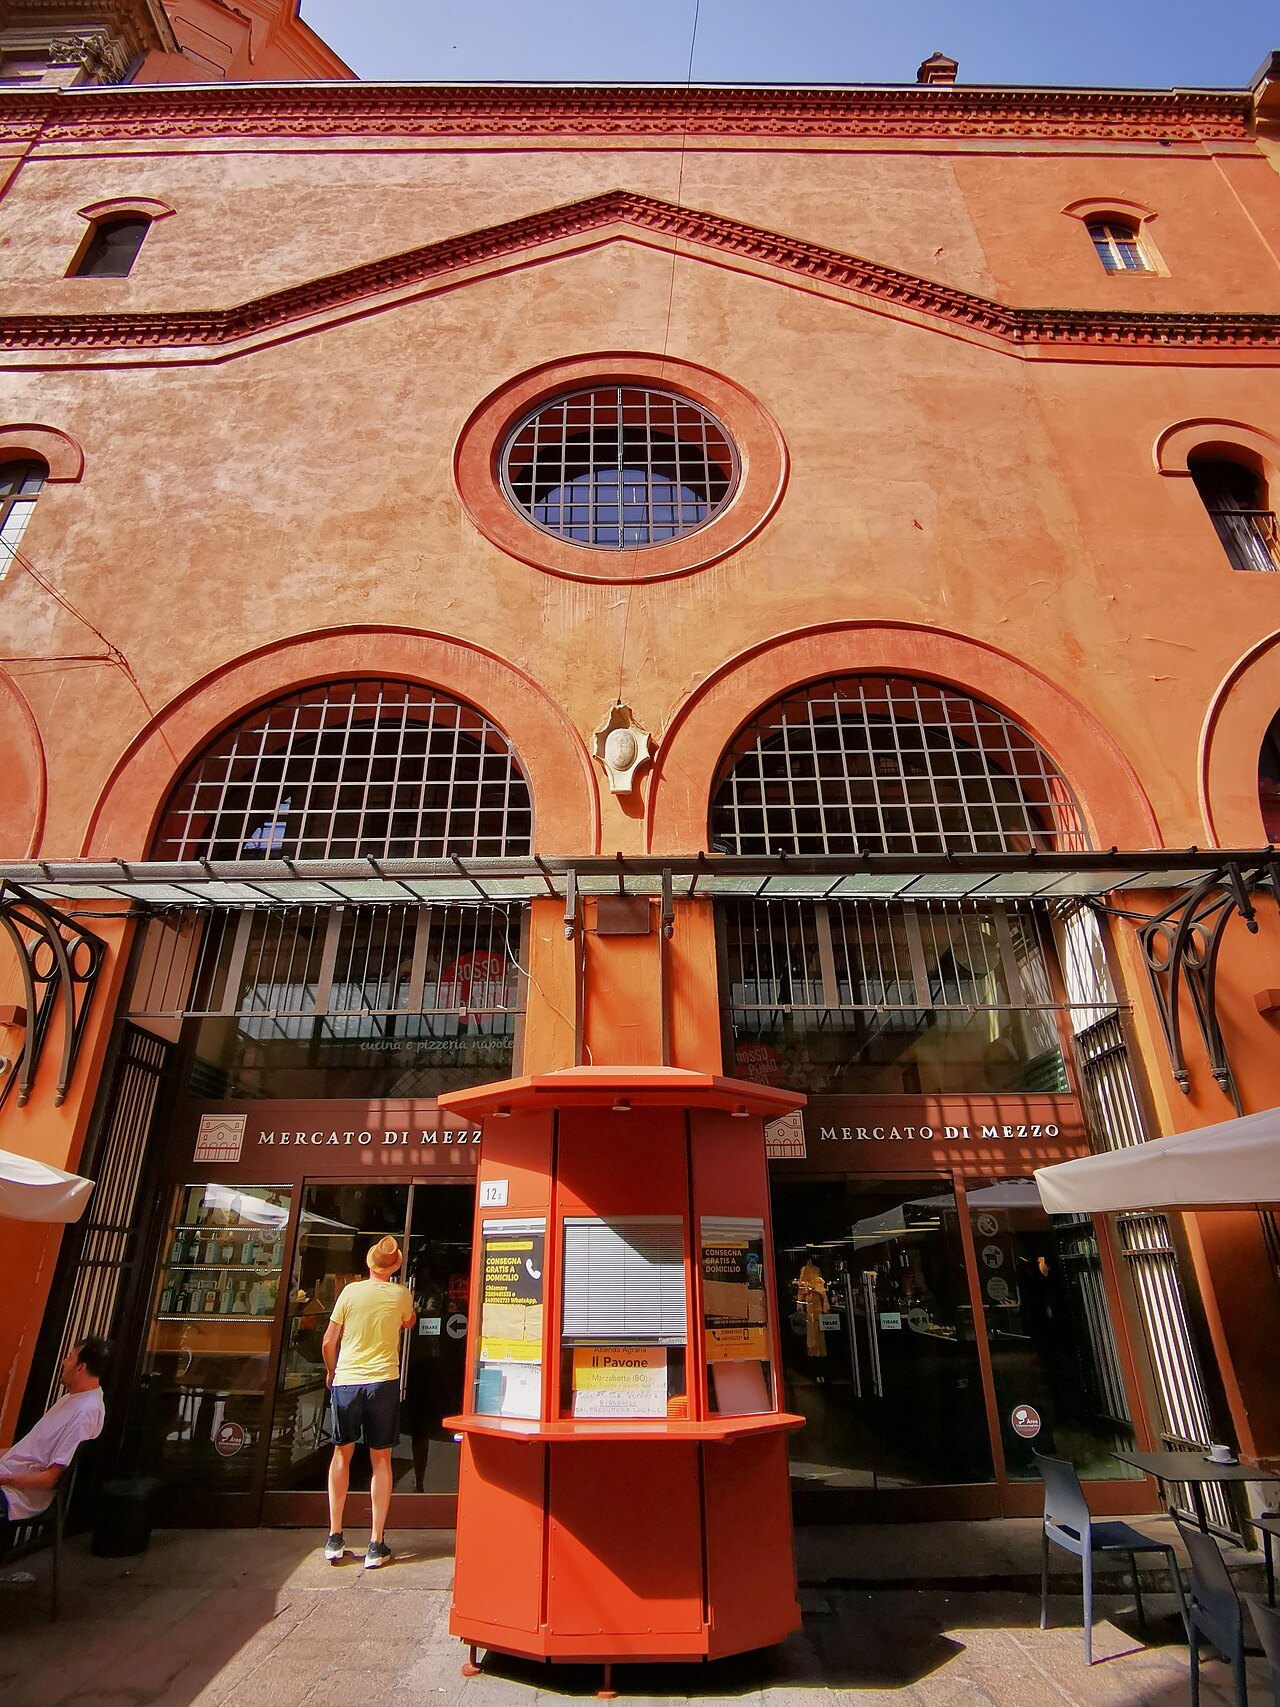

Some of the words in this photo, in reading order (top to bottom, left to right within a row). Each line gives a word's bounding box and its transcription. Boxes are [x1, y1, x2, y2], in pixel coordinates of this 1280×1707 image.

[360, 1039, 401, 1050] cucina
[406, 1041, 413, 1050] e
[416, 1039, 467, 1053] pizzeria
[735, 1047, 769, 1065] ROSSO
[748, 1058, 778, 1076] POMO
[820, 1126, 934, 1140] MERCATO
[944, 1126, 972, 1139] DI
[981, 1124, 1059, 1139] MEZZO
[257, 1131, 372, 1145] MERCATO
[381, 1131, 410, 1144] DI
[705, 1249, 742, 1257] CONSEGNA
[486, 1257, 521, 1265] CONSEGNA
[705, 1257, 730, 1265] GRATIS
[730, 1257, 737, 1265] A
[485, 1265, 509, 1273] GRATIS
[509, 1265, 515, 1273] A
[705, 1265, 741, 1273] DOMICILIO
[485, 1273, 520, 1281] DOMICILIO
[622, 1346, 647, 1355] Agraria
[592, 1356, 599, 1368] Il
[603, 1356, 648, 1368] Pavone
[592, 1374, 631, 1382] Marzabotto
[632, 1374, 648, 1382] (BO)
